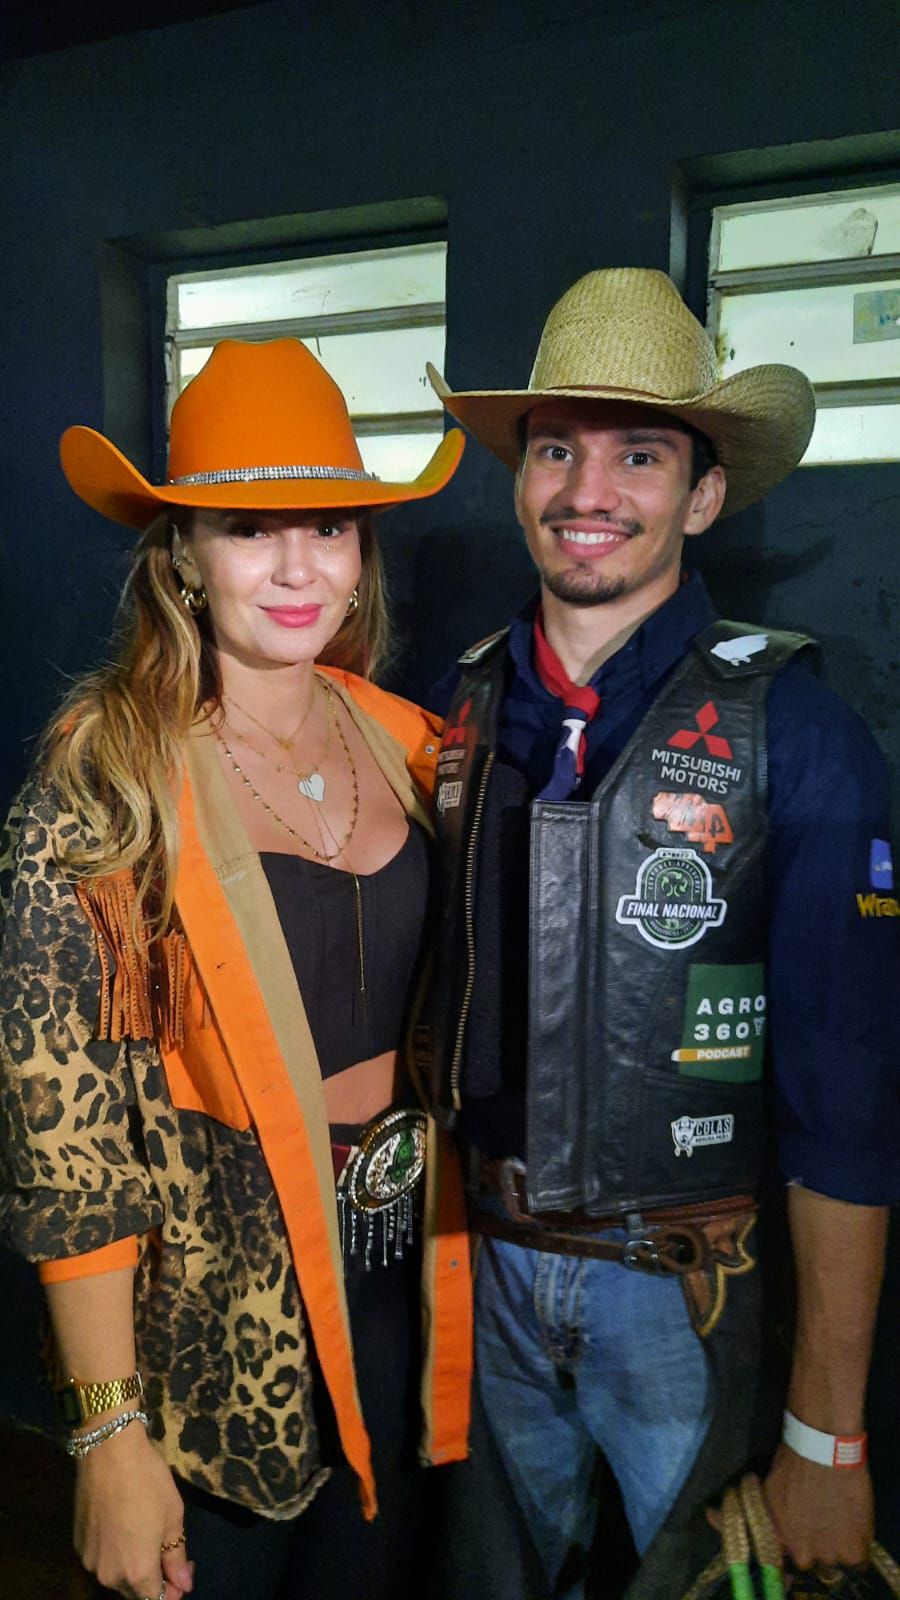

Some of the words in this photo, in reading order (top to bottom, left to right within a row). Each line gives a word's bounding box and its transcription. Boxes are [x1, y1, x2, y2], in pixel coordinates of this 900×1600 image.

[651, 749, 742, 782] MITSUBISHI
[660, 765, 729, 795] MOTORS
[626, 902, 659, 917] FINAL
[662, 903, 718, 919] NACIONAL
[856, 893, 900, 918] Wra
[696, 995, 767, 1016] AGRO
[694, 1022, 750, 1041] 360
[697, 1046, 751, 1060] PODCAST
[695, 1118, 730, 1136] COLAS
